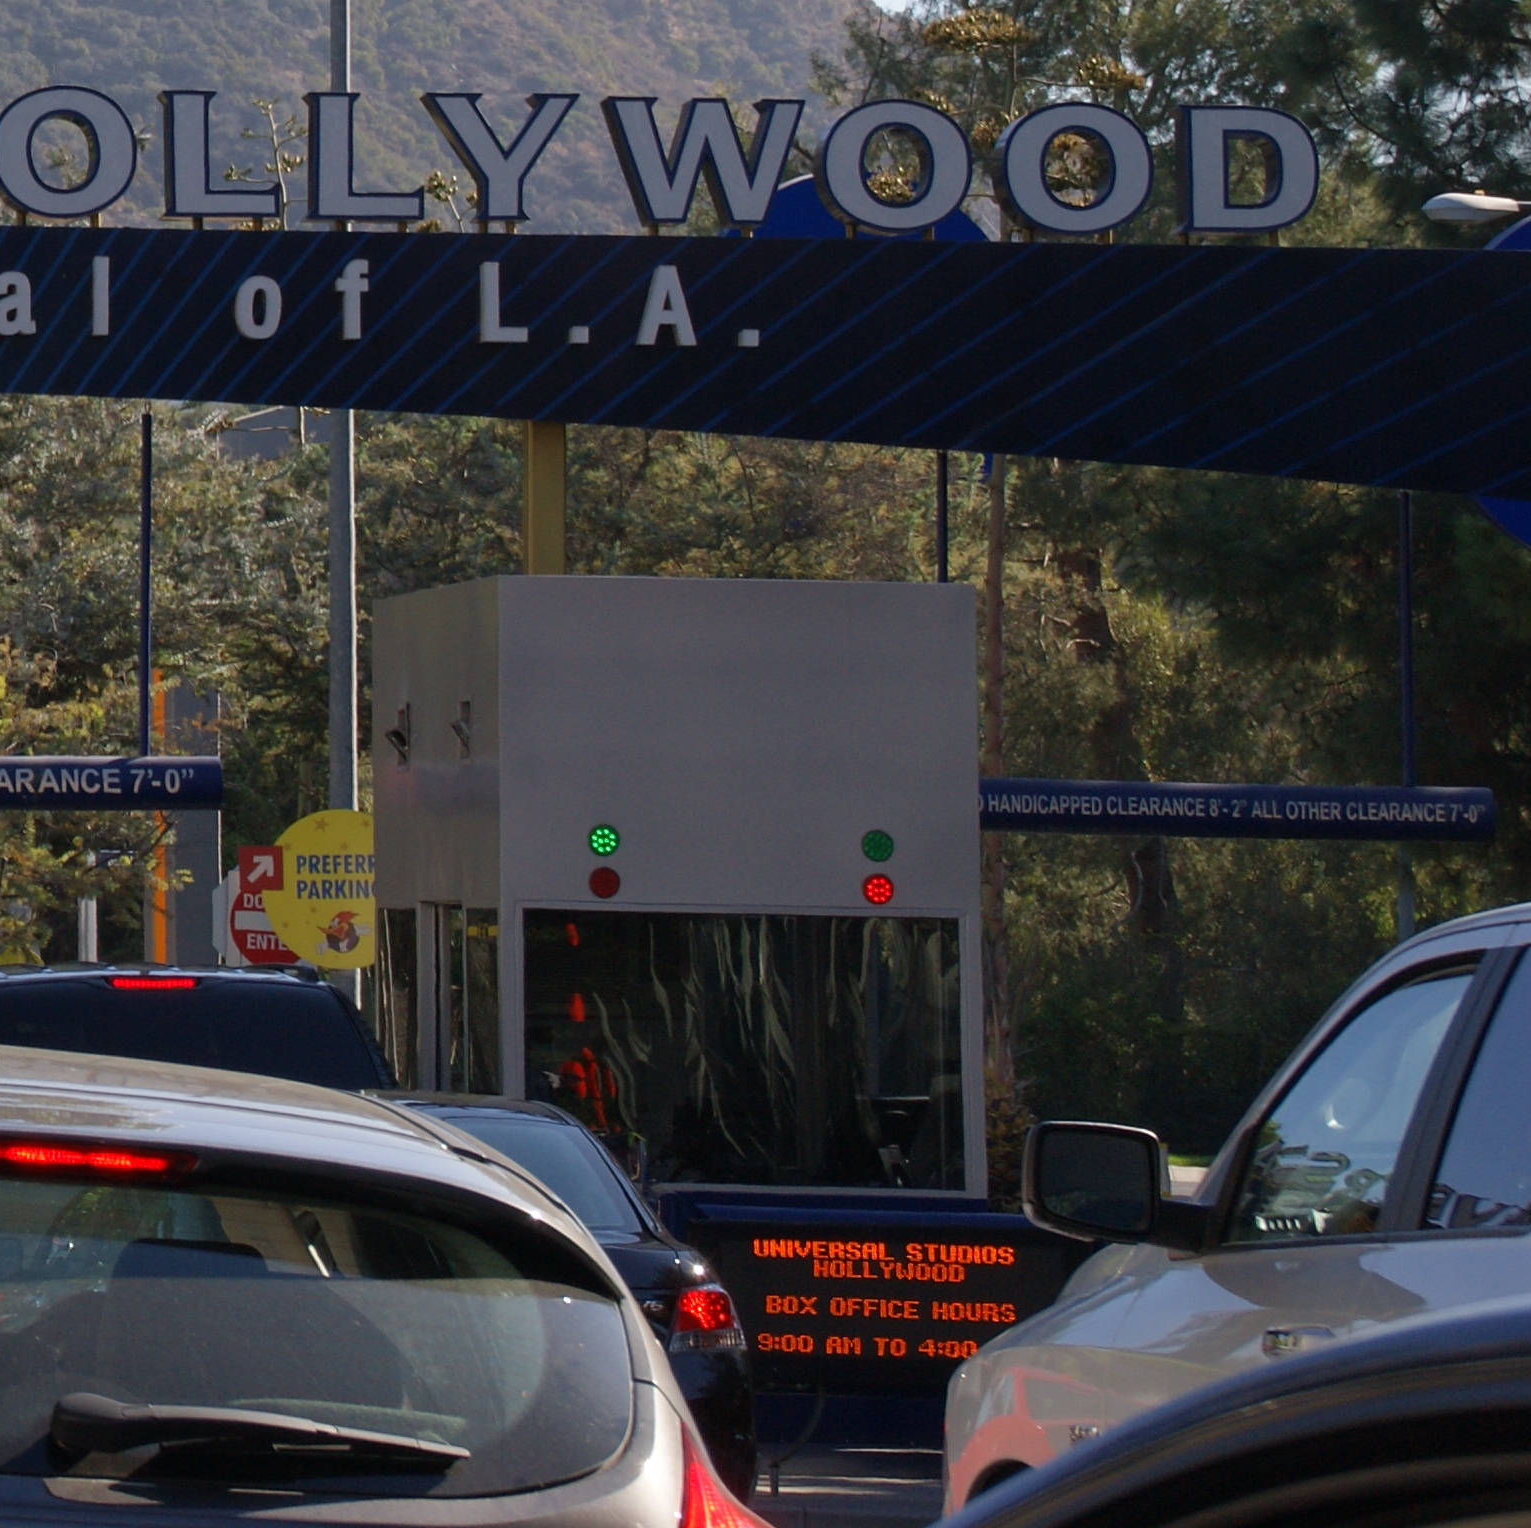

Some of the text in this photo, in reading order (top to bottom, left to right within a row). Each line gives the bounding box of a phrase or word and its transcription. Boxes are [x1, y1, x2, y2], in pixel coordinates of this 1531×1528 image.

[233, 258, 370, 342] of
[478, 261, 761, 348] L.A.
[988, 794, 1103, 816] HANDICAPPED
[1106, 796, 1205, 817] CLEARANCE
[1251, 800, 1282, 819] ALL
[1285, 800, 1340, 820] OTHER
[1346, 801, 1446, 822] CLEARANCE
[296, 854, 376, 874] PREFERR
[753, 1238, 1016, 1266] UNIVERSAL STUDIOS
[813, 1260, 966, 1283] HOLLYWOOD
[765, 1295, 1017, 1323] BOX OFFICE HOURS
[757, 1332, 814, 1354] 9:00
[825, 1336, 862, 1357] AM
[874, 1337, 907, 1358] TO
